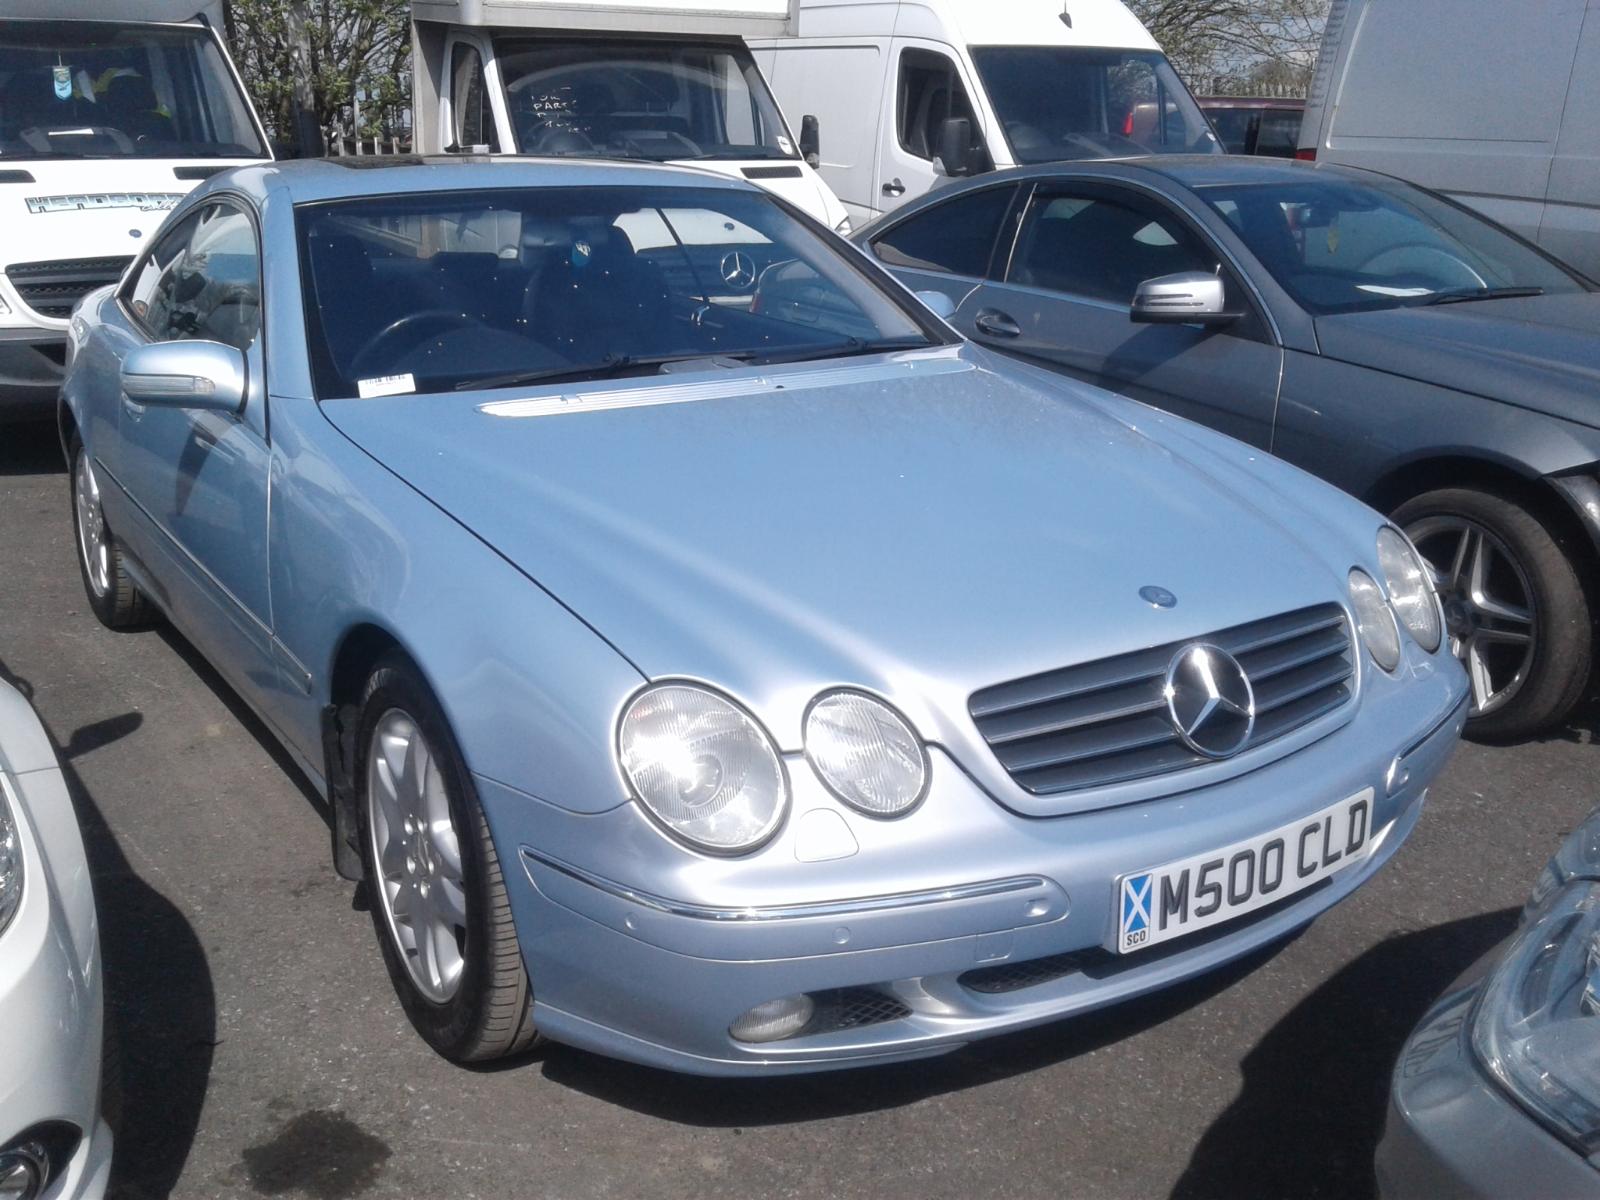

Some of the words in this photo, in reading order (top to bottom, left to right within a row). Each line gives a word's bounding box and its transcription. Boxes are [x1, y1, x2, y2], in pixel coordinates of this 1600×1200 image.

[1159, 837, 1285, 931] M500
[1297, 799, 1368, 879] CLD
[1126, 929, 1146, 946] SCO
